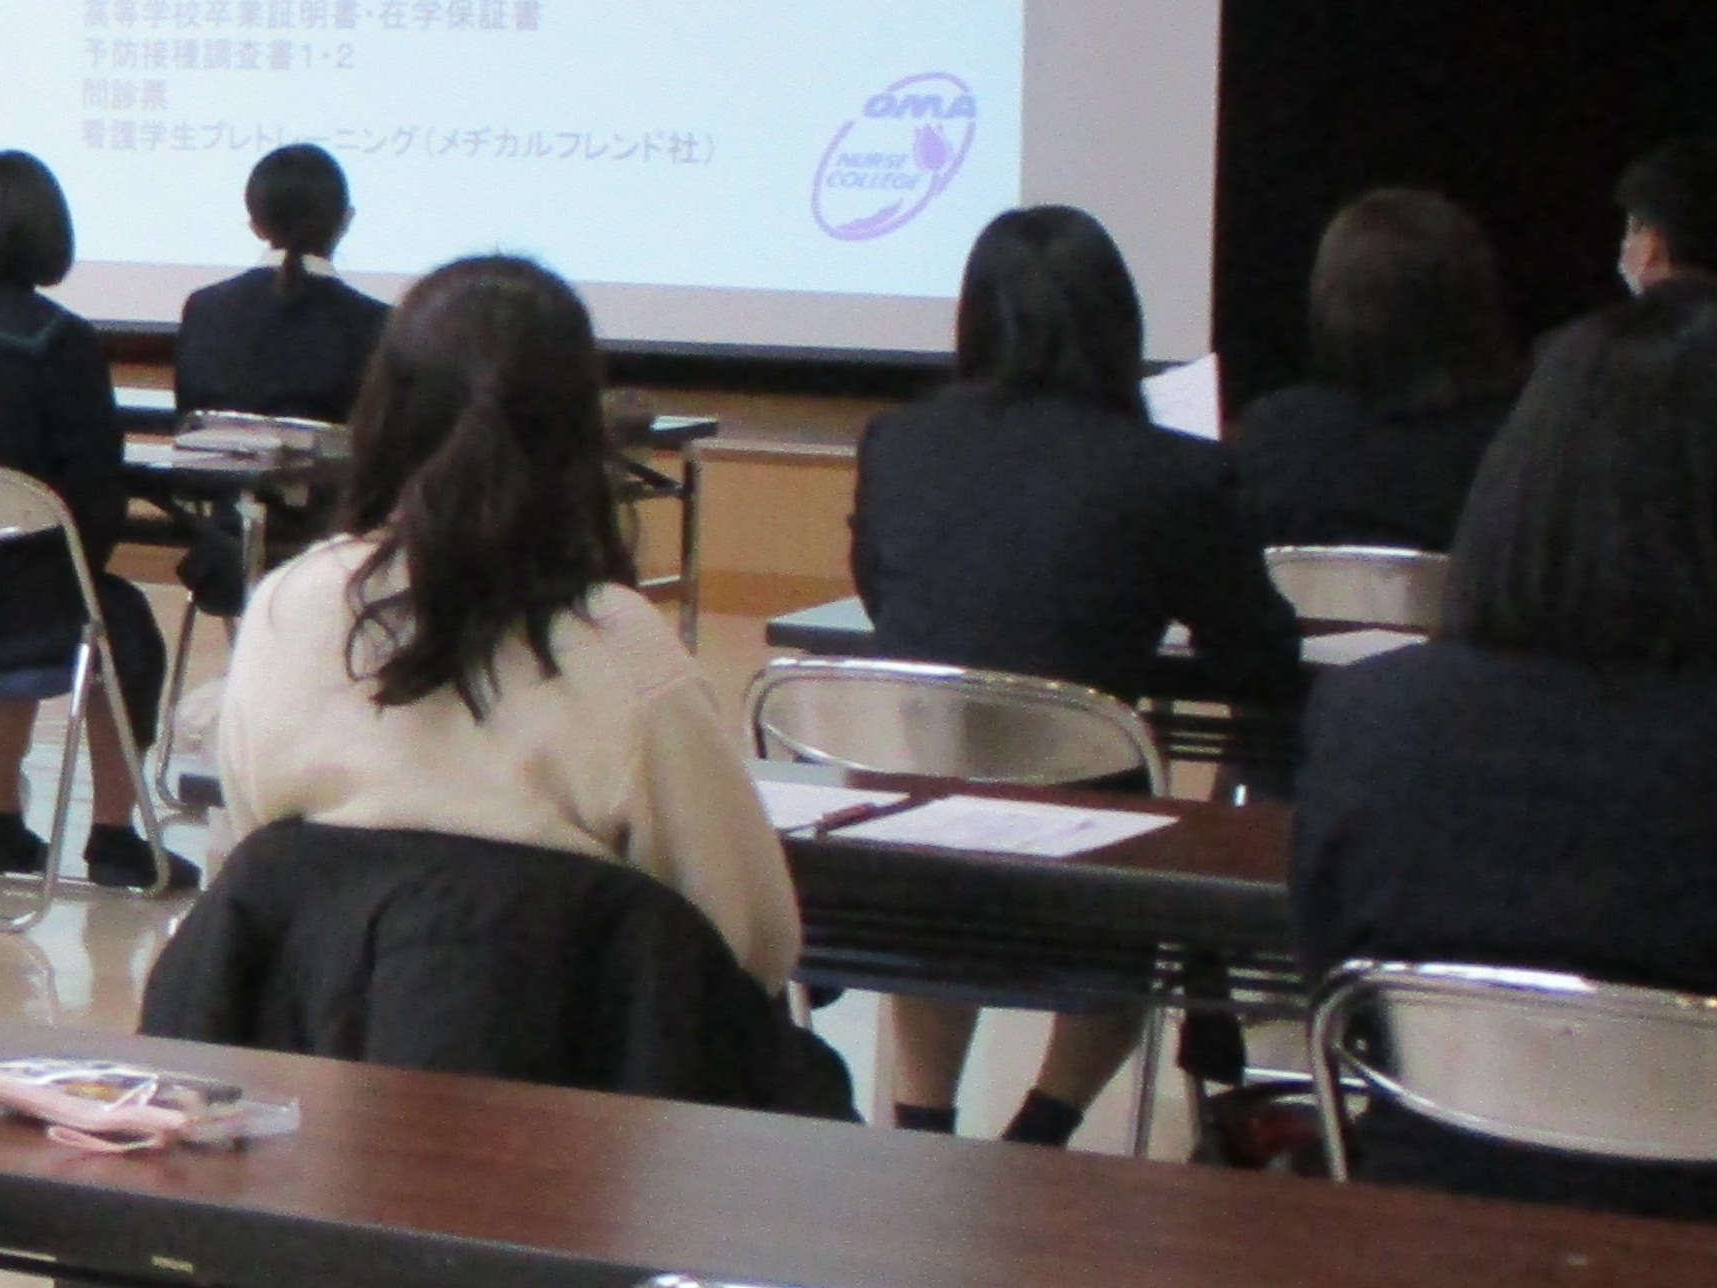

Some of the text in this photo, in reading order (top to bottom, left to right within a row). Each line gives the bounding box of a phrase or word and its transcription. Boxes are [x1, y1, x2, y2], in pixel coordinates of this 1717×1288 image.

[82, 78, 168, 112] 問診票
[836, 152, 909, 169] NURSE
[827, 170, 923, 190] COLLEGE
